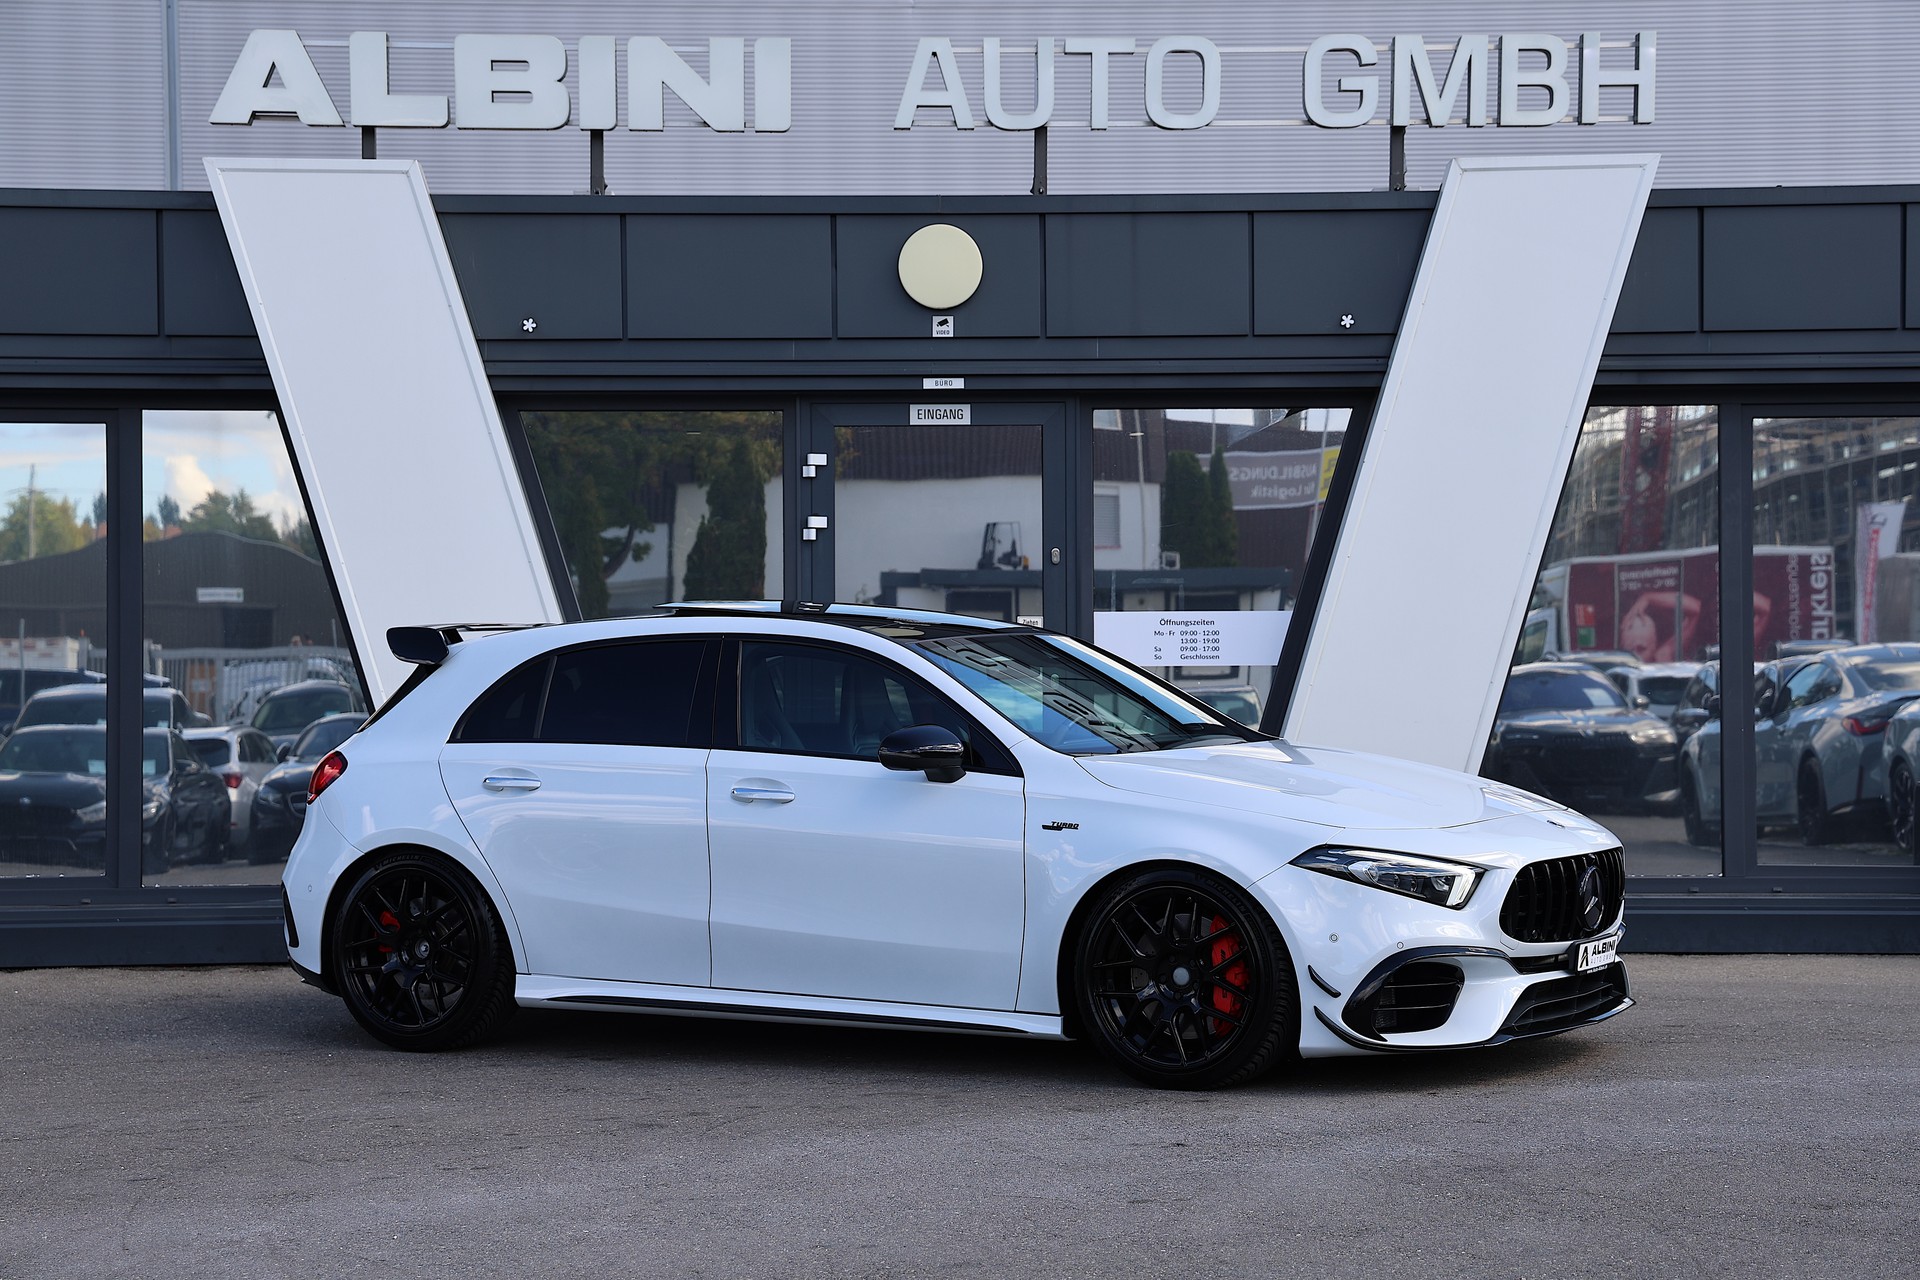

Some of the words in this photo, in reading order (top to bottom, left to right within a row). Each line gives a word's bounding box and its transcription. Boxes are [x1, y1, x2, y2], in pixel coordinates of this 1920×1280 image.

[208, 29, 792, 132] ALBINI
[893, 34, 1222, 131] AUTO
[1302, 31, 1658, 130] GMBH
[934, 378, 953, 387] BÜRO
[917, 408, 964, 420] EINGANG
[1159, 618, 1215, 627] Öffnungszeiten
[1051, 821, 1079, 830] TURBO
[382, 853, 421, 866] MICHELIN
[1206, 878, 1247, 914] MICHELIN
[1591, 940, 1616, 956] ALBINI
